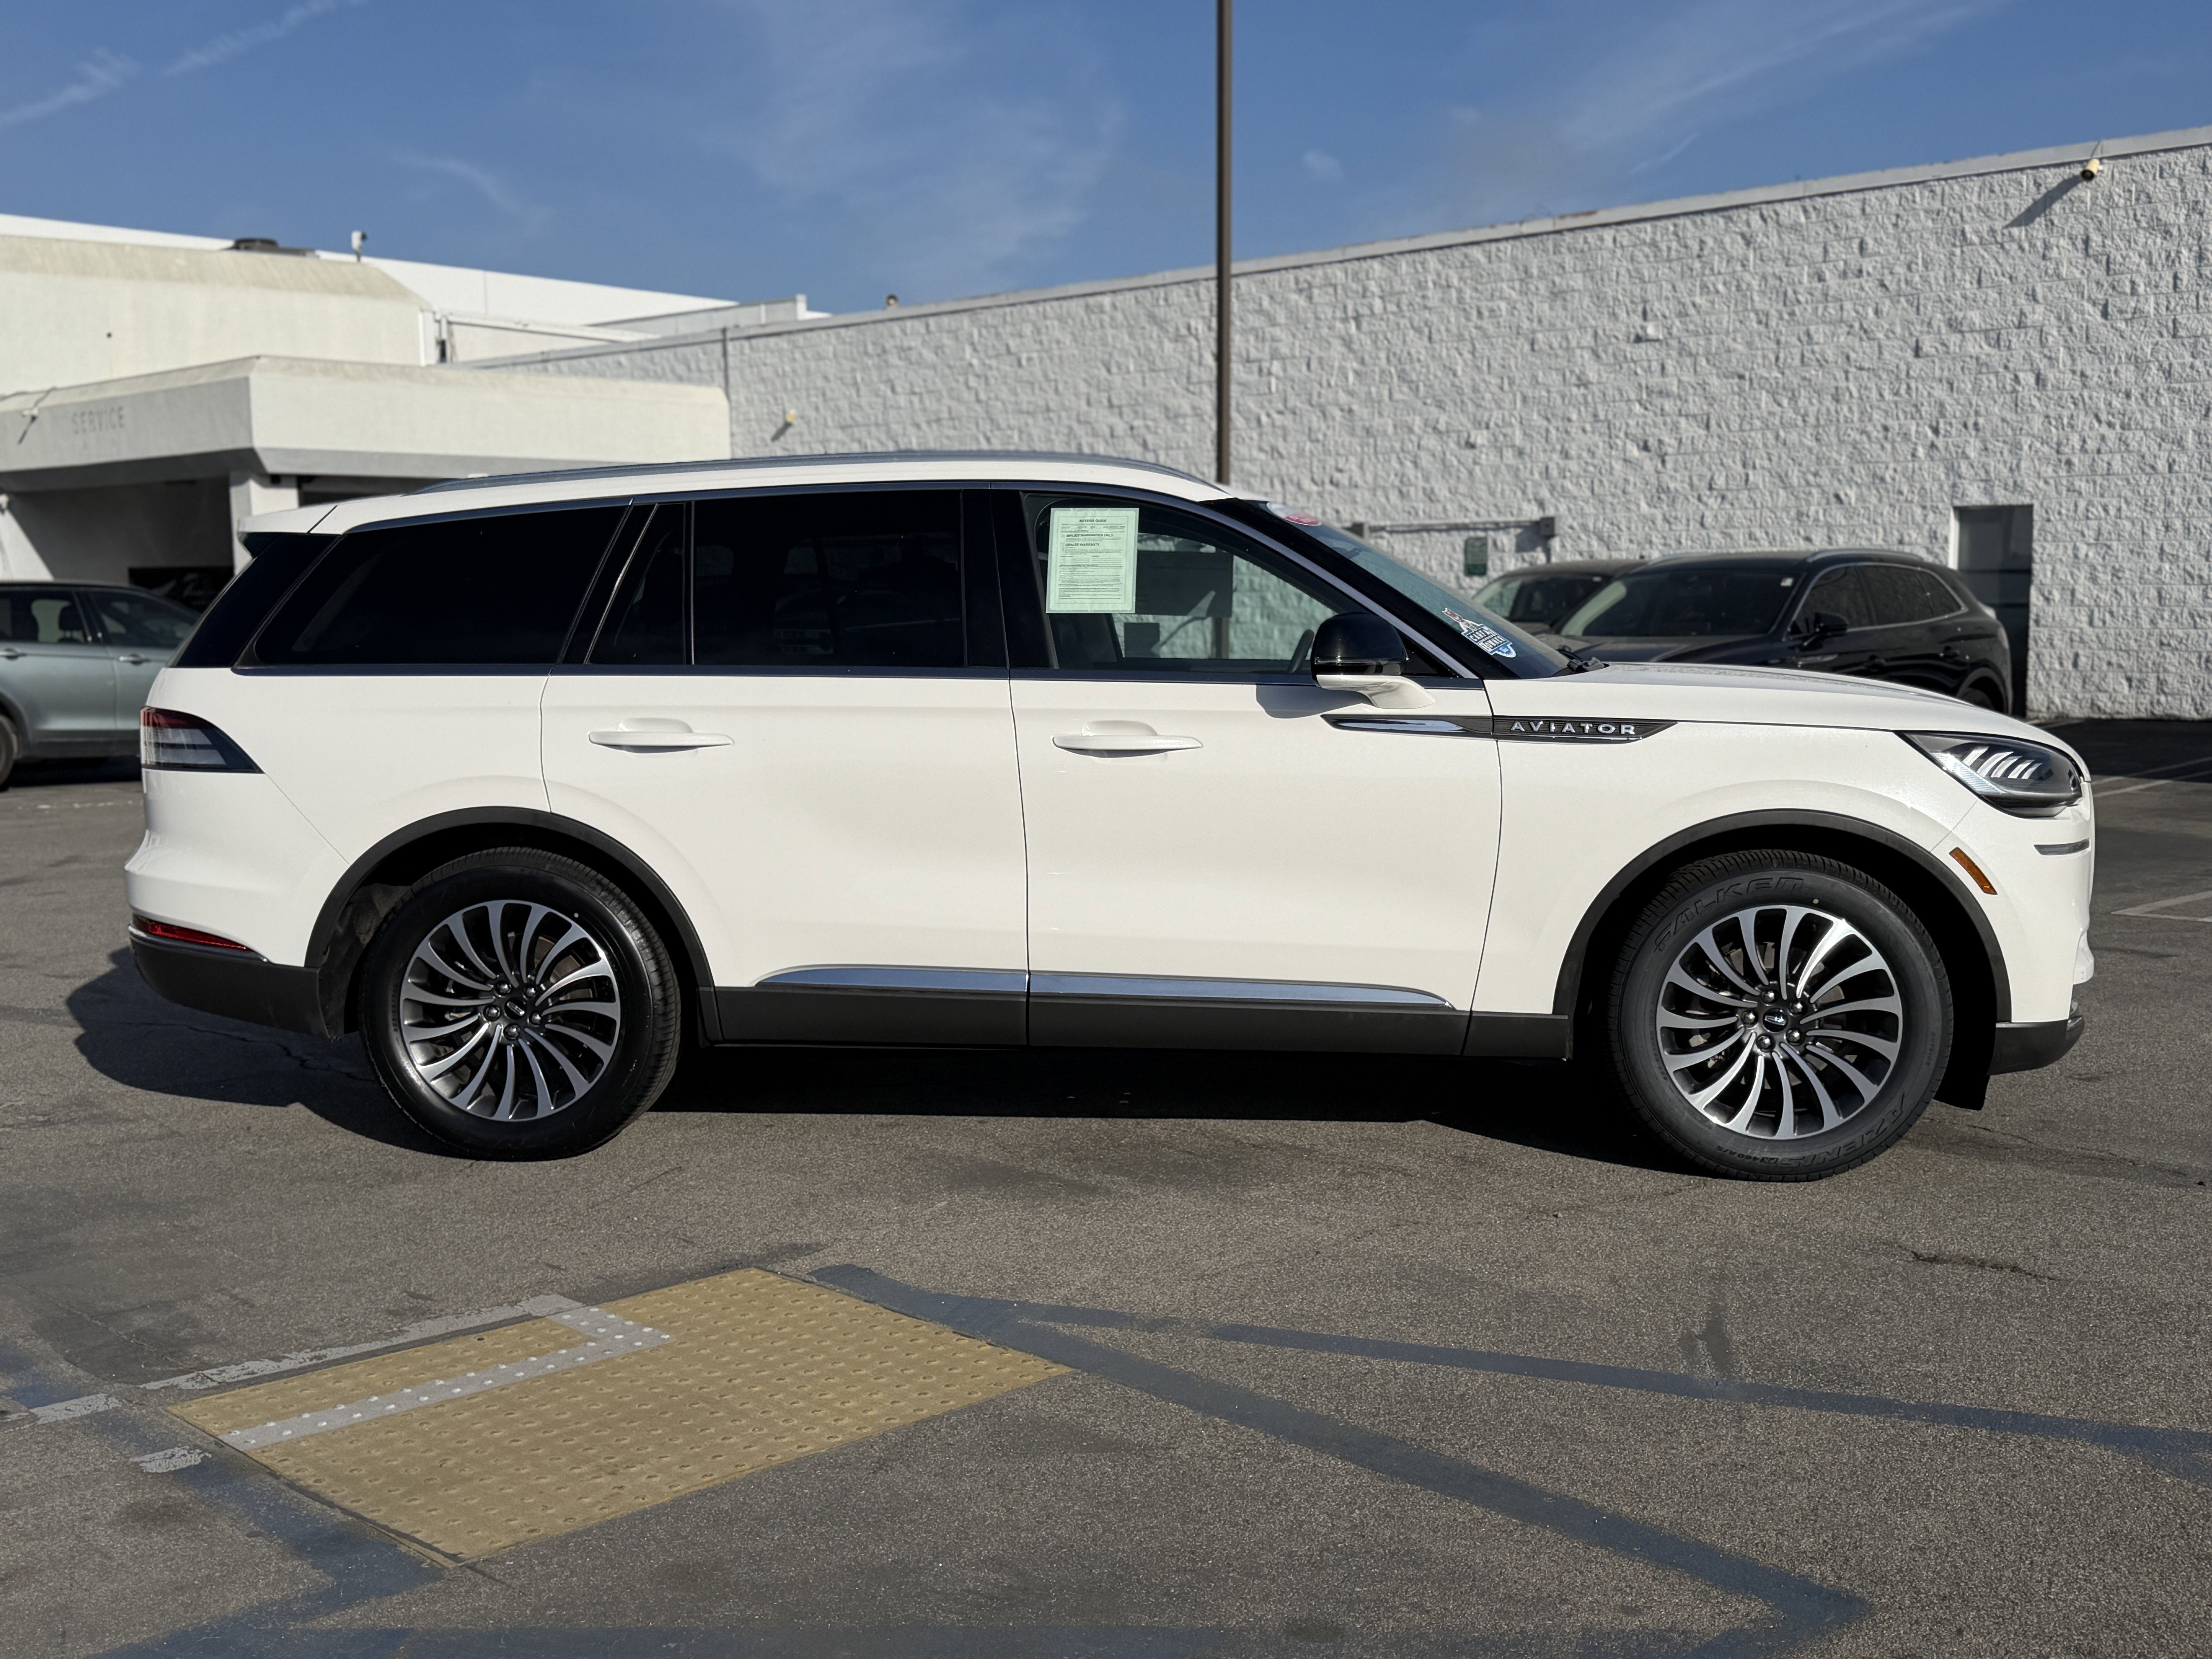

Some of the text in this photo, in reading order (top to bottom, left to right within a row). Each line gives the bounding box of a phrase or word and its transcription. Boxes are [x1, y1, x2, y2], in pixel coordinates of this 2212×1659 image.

[72, 406, 125, 434] SERVICE
[1510, 721, 1635, 735] AVIATOR
[1654, 877, 1805, 953] FALKEN
[1781, 1092, 1905, 1168] AZENIS
